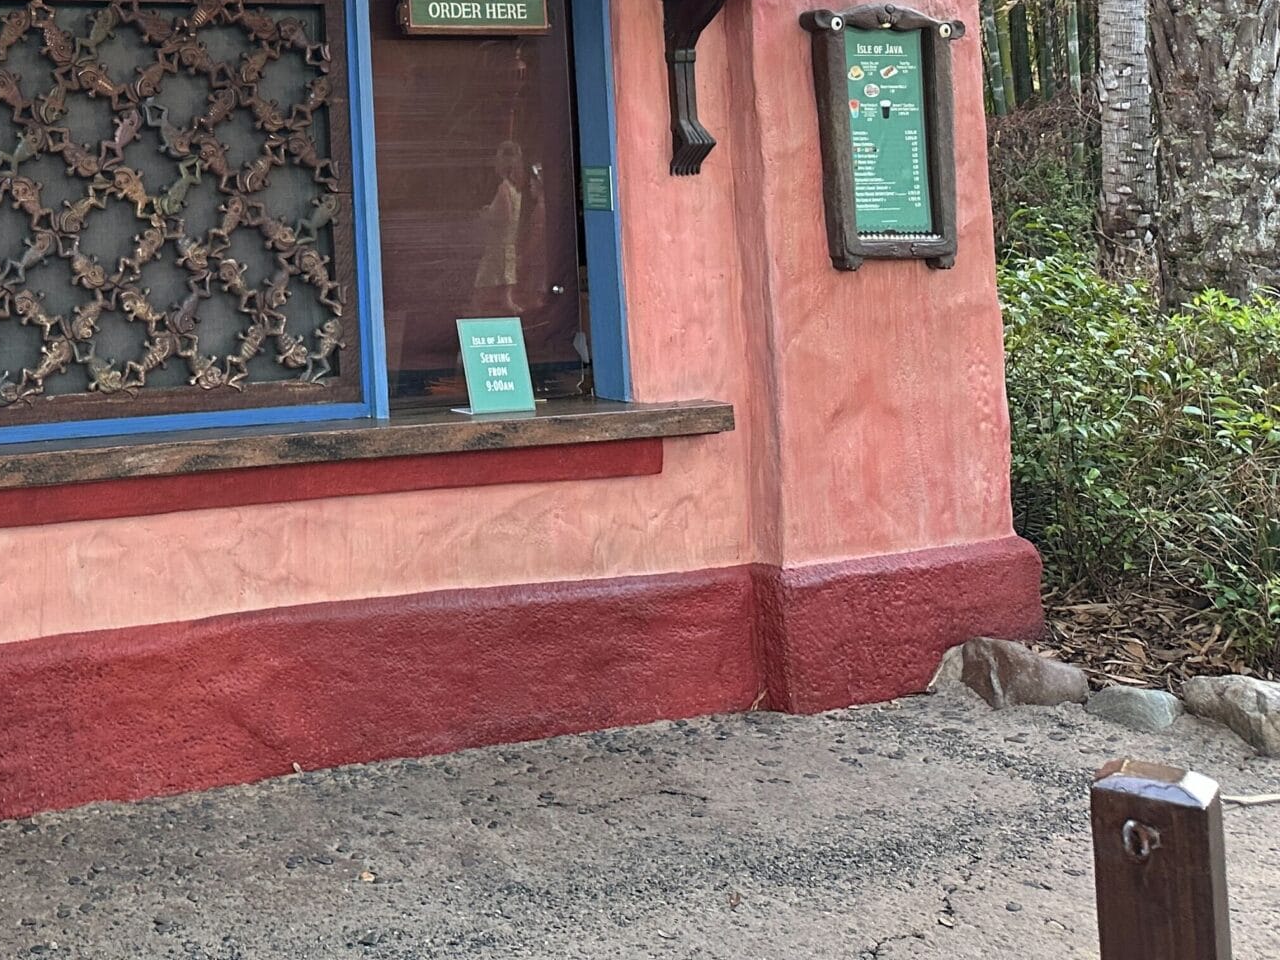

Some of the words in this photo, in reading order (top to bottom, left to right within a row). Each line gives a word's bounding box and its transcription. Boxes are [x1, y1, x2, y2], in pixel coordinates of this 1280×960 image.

[428, 2, 482, 18] ORDER
[485, 3, 527, 19] HERE
[856, 43, 872, 54] ISLE
[873, 45, 883, 54] OF
[885, 43, 903, 54] JAVA
[480, 352, 511, 364] SERVING
[488, 366, 508, 377] FROM
[485, 380, 515, 392] 9:00AM
